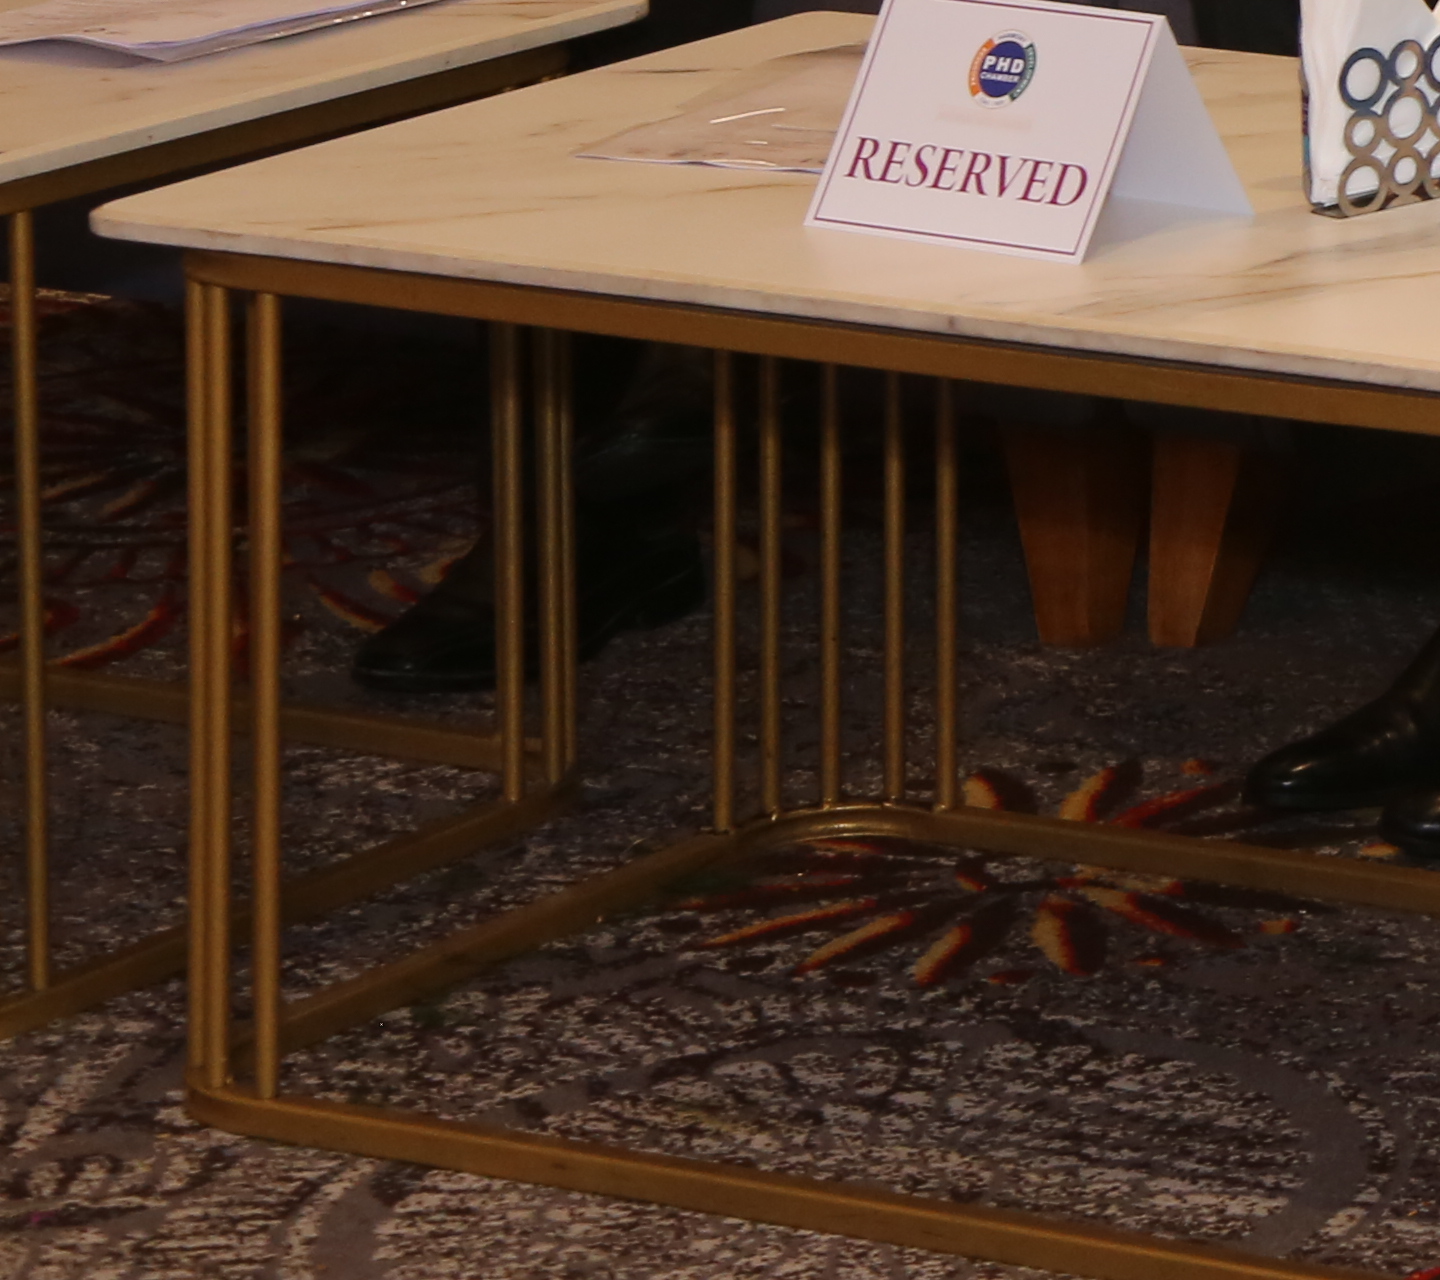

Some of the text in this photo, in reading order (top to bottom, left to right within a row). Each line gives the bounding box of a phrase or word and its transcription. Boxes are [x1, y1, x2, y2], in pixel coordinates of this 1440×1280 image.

[982, 55, 1025, 74] PHD
[980, 71, 1020, 83] CHAMBER
[843, 136, 1088, 207] RESERVED
